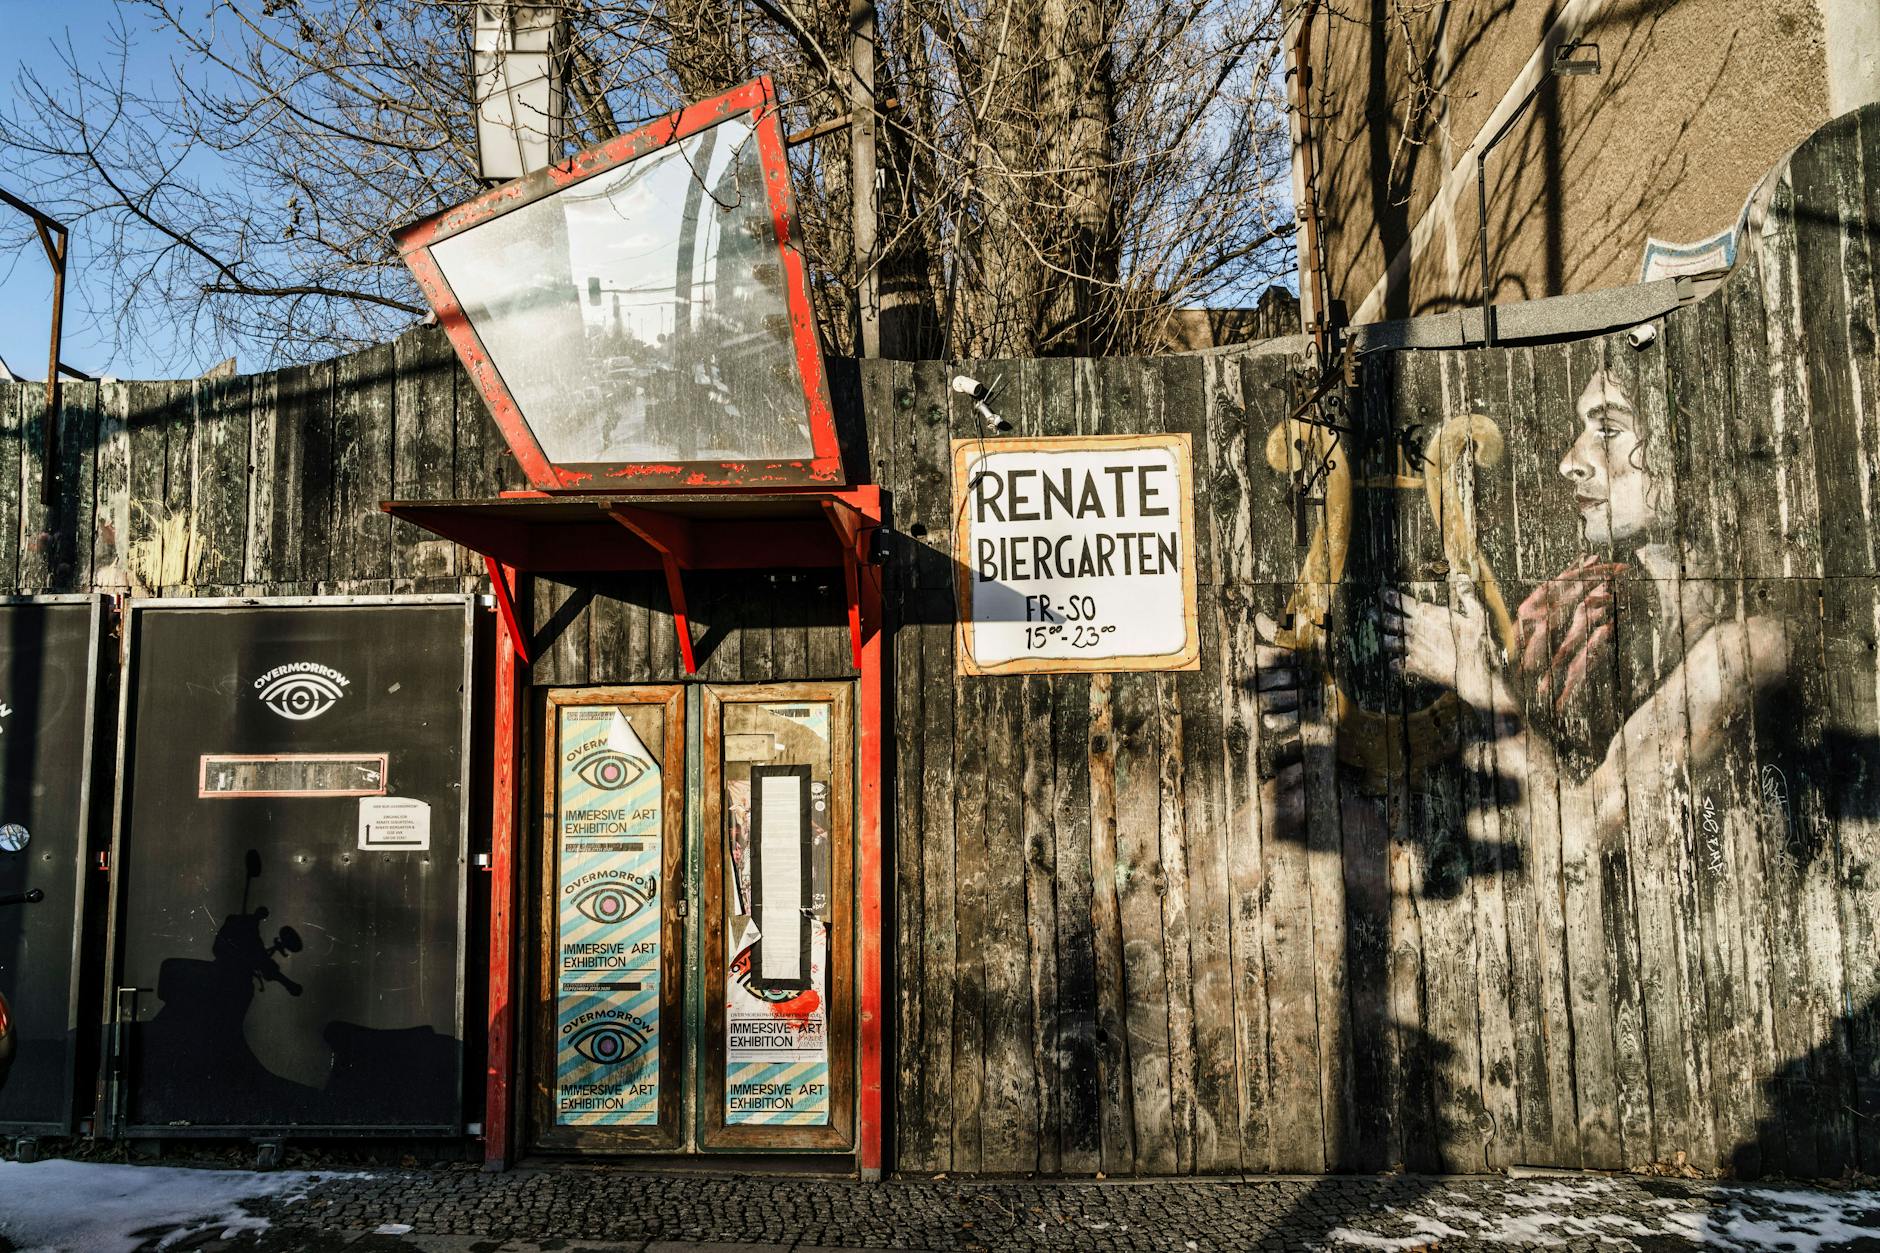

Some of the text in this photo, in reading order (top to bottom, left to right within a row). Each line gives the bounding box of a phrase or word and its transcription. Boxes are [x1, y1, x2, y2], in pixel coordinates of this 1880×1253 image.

[975, 465, 1169, 522] RENATE
[978, 531, 1179, 583] BIERGARTEN
[253, 661, 351, 689] OVERMORROW
[566, 738, 608, 762] OVERM
[565, 809, 657, 821] IMMERSIVE ART
[565, 822, 627, 834] EXHIBITION
[564, 943, 657, 955] IMMERSIVE ART
[564, 956, 627, 968] EXHIBITION
[562, 1009, 654, 1034] OVERMORROW
[730, 1023, 822, 1034] IMMERSIVE ART
[730, 1035, 793, 1047] EXHIBITION
[561, 1084, 655, 1096] IMMERSIVE ART
[730, 1084, 825, 1096] IMMERSIVE ART
[561, 1098, 624, 1109] EXHIBITION
[730, 1097, 794, 1109] EXHIBITION
